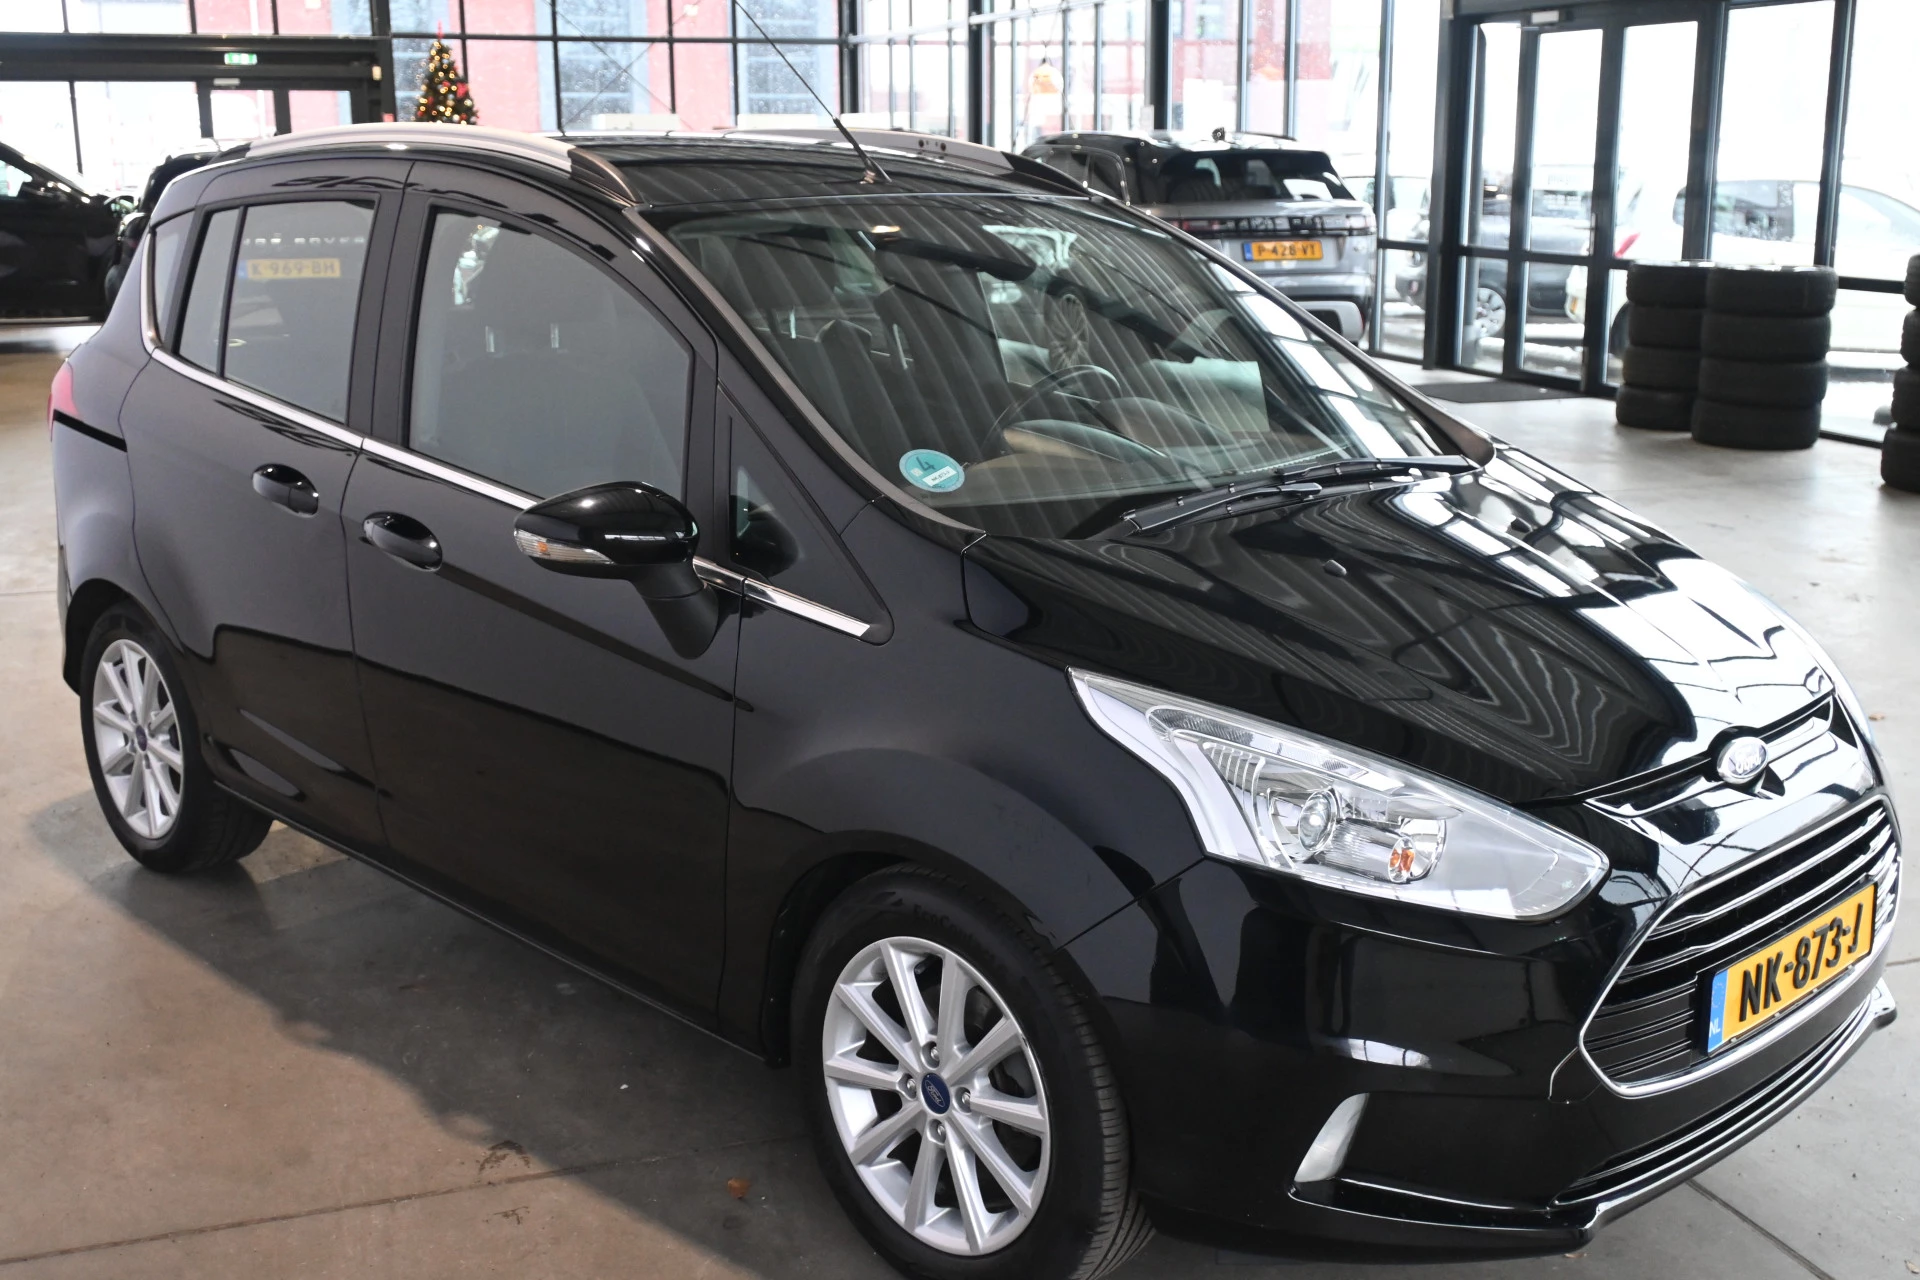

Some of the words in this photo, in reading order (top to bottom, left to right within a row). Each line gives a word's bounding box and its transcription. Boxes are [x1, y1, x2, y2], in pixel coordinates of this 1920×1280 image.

[916, 456, 936, 471] 4
[1739, 903, 1863, 1022] NK-873-J
[1709, 1020, 1721, 1036] NL
